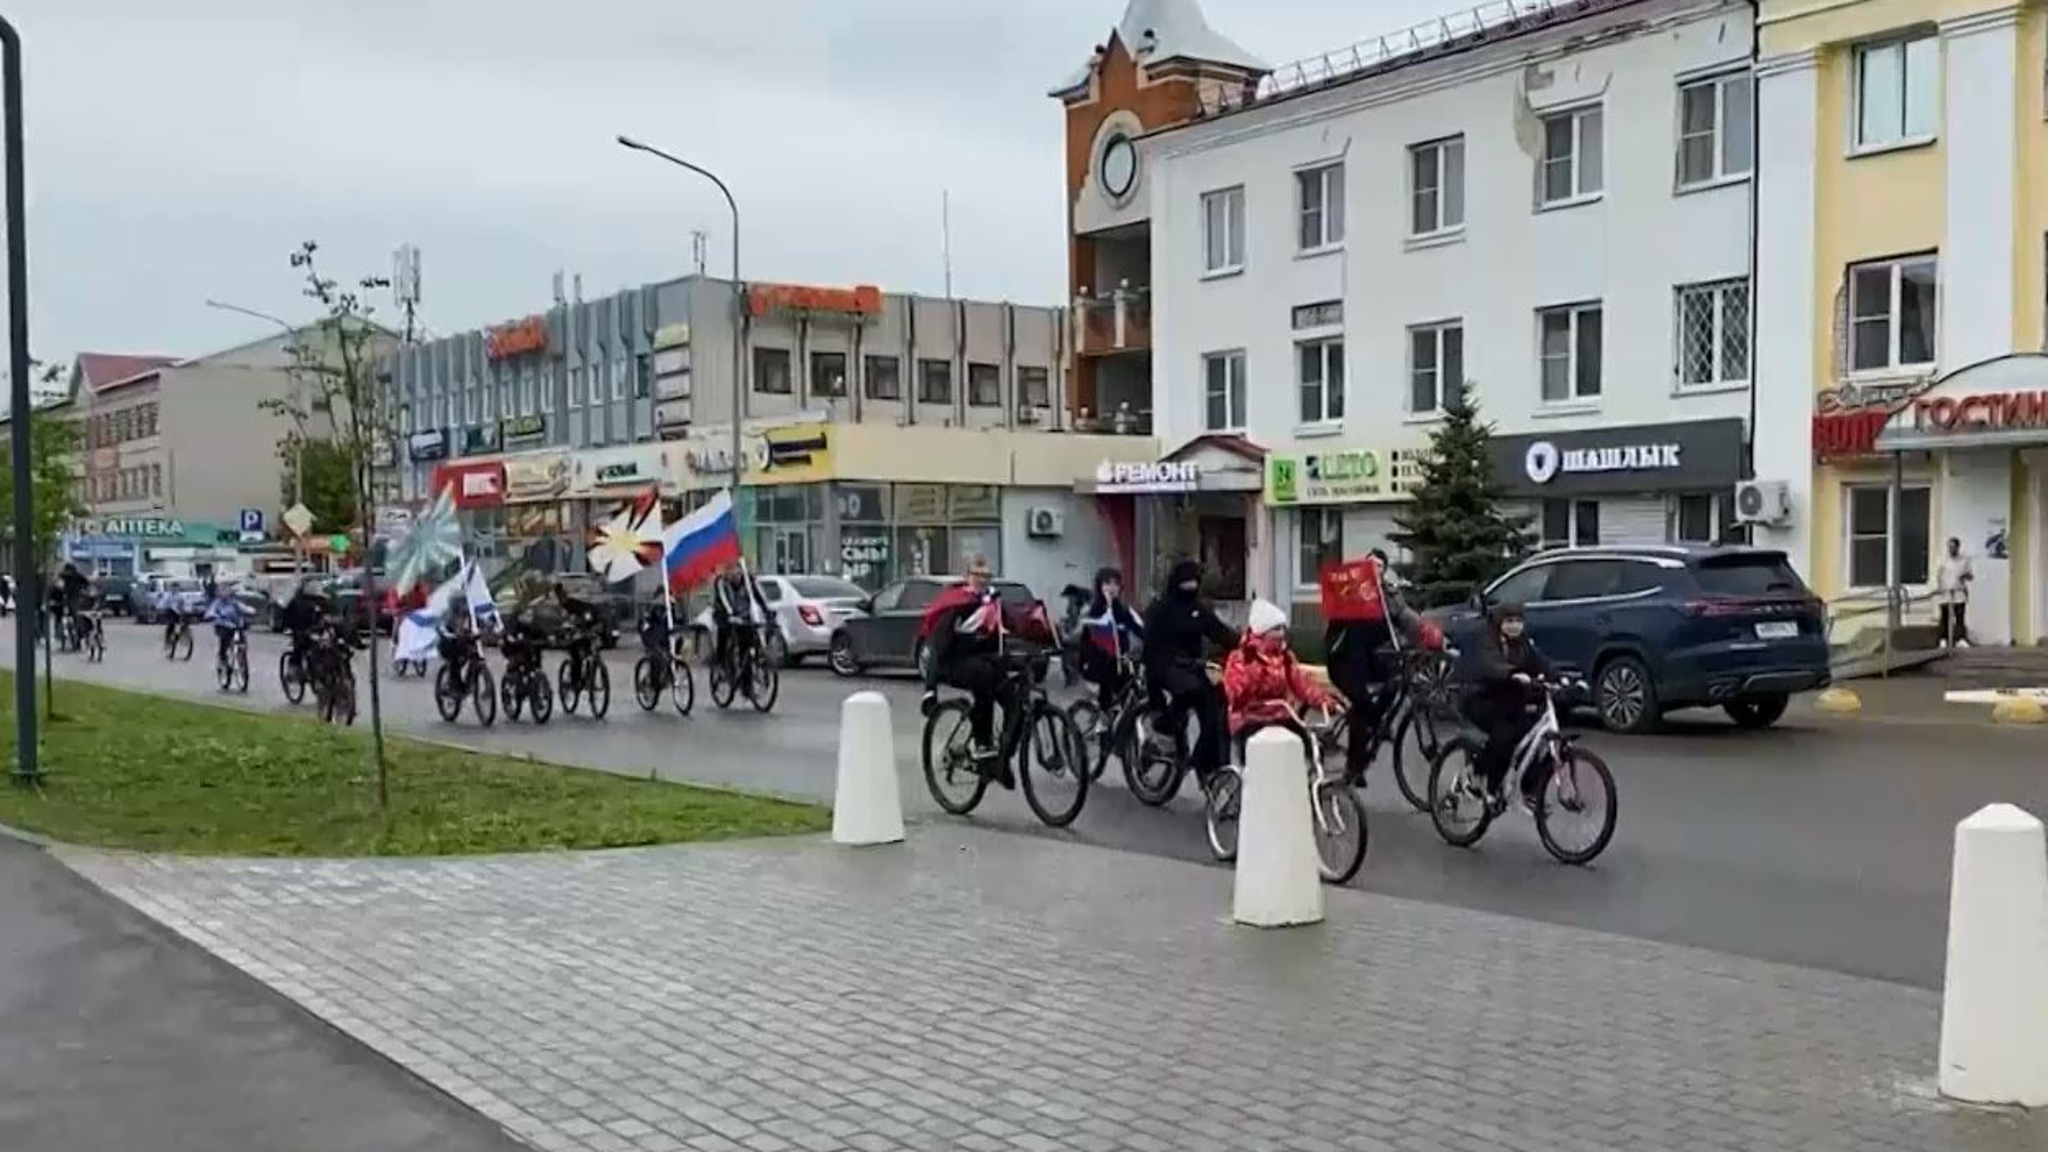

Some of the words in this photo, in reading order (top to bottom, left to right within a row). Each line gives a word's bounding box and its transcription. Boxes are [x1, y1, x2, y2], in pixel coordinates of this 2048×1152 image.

[1562, 444, 1680, 472] ШАШЛЫК
[1115, 462, 1198, 483] РЕМОНТ
[106, 519, 184, 536] АПТЕКА
